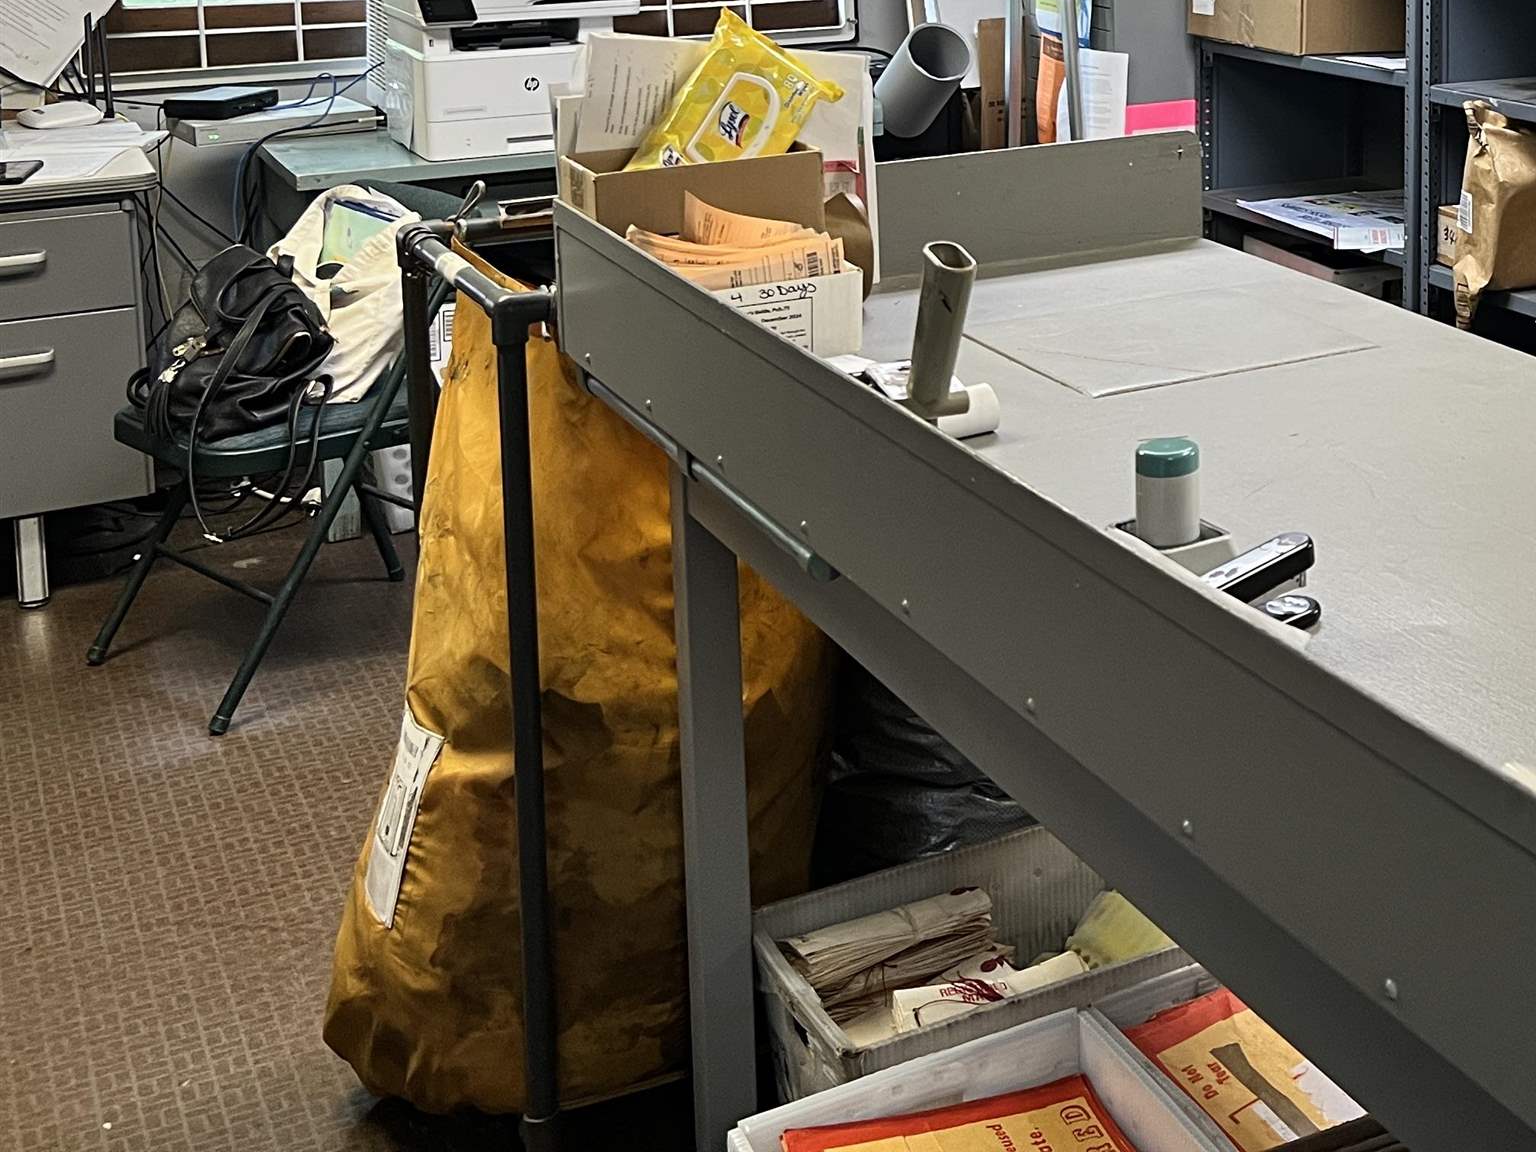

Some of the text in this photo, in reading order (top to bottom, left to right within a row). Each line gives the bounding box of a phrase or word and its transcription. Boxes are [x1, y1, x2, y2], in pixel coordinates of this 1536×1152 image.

[719, 103, 741, 141] Lysol
[758, 287, 776, 299] 30
[776, 280, 817, 297] Days
[1180, 1063, 1218, 1102] Do Not
[1207, 1060, 1232, 1085] Tear
